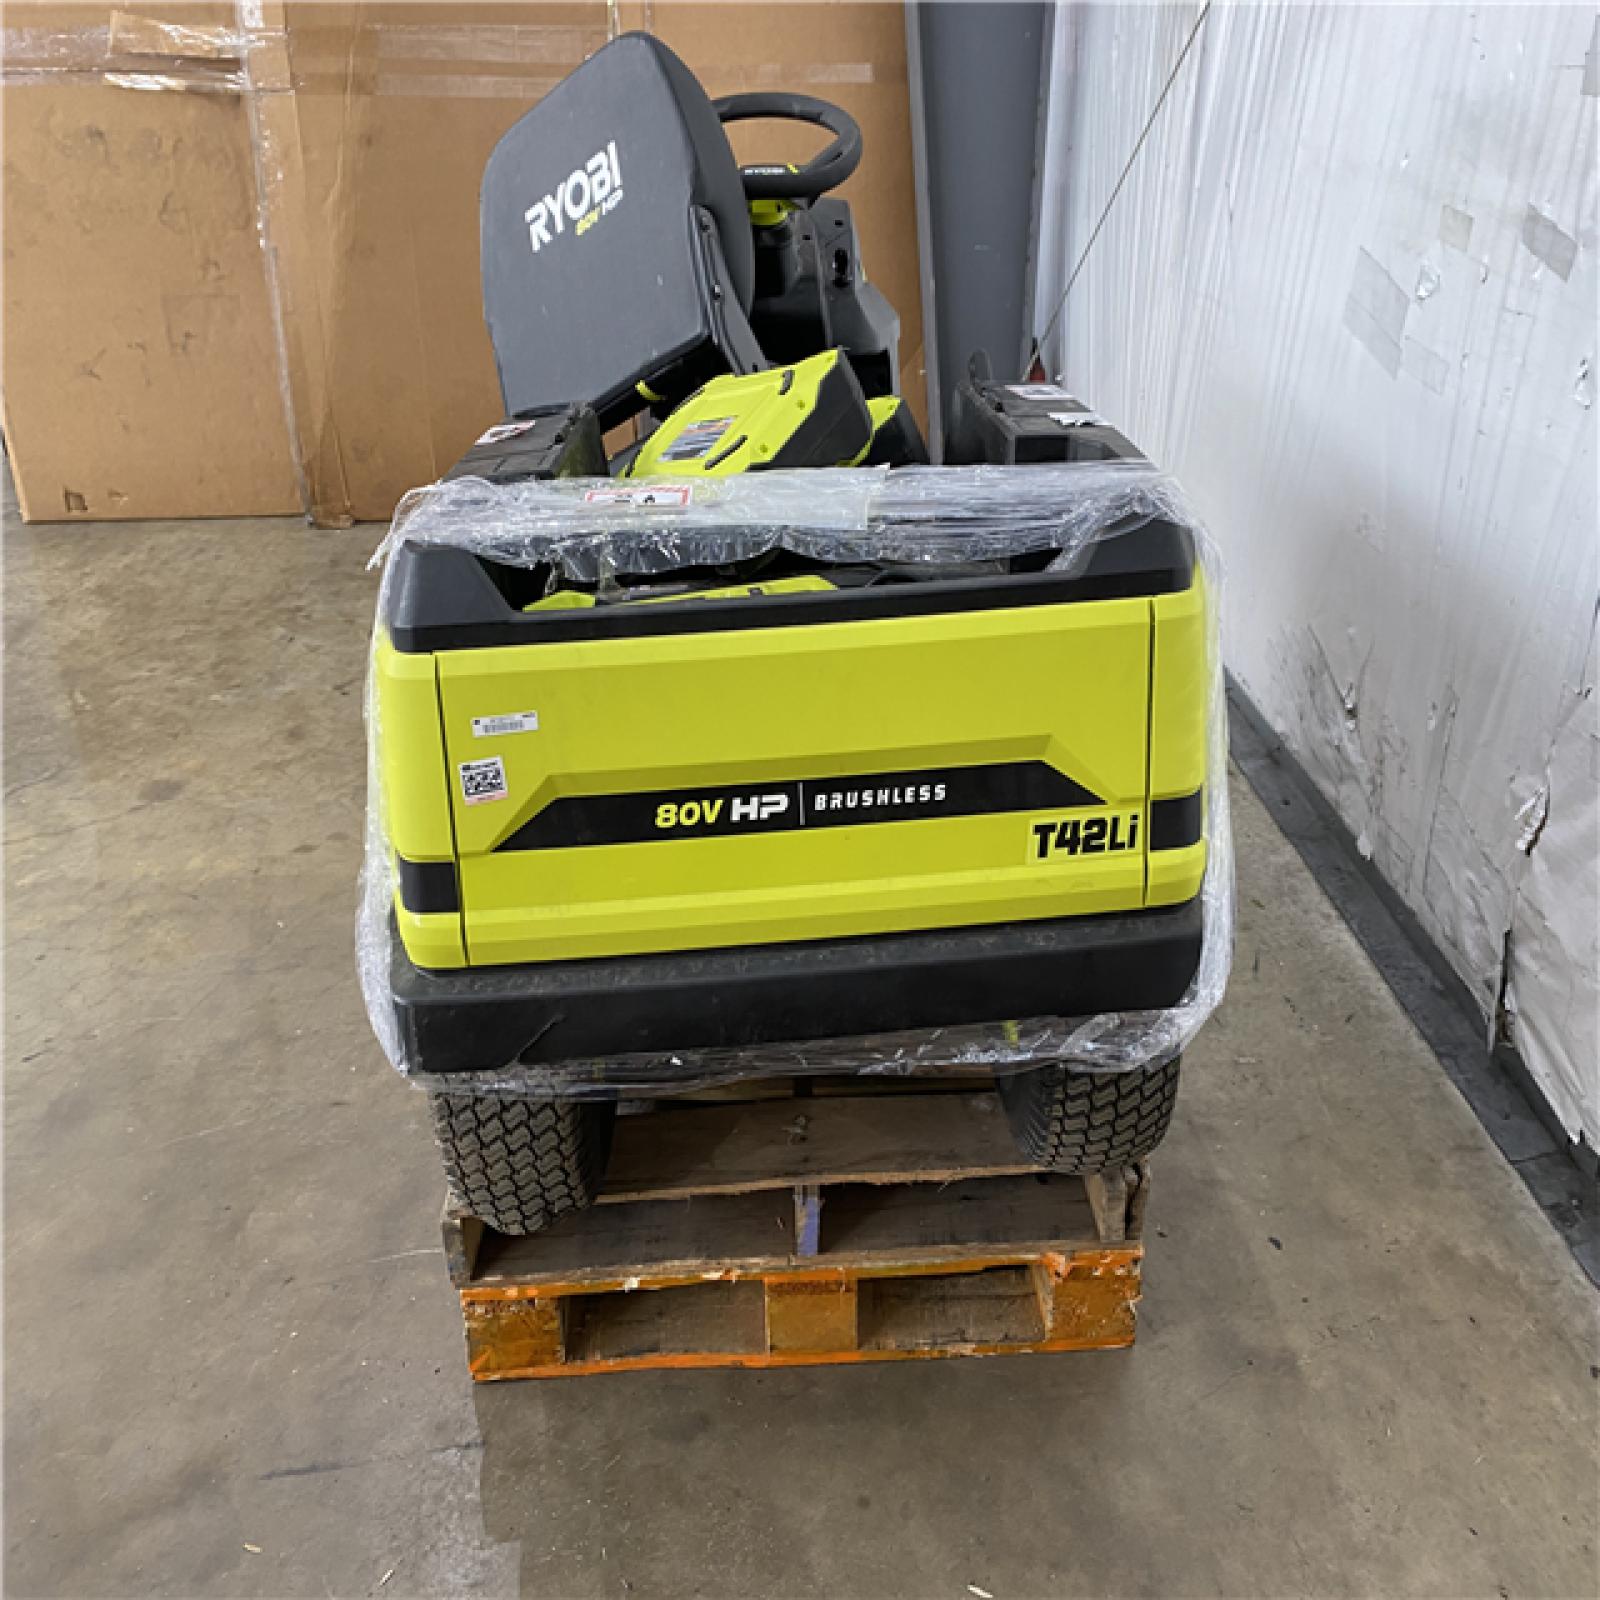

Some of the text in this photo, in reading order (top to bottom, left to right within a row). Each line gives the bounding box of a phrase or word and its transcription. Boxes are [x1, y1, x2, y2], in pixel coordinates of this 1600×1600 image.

[525, 140, 622, 253] RYOBI
[655, 784, 946, 828] 80V HP BRUSHLESS
[1033, 814, 1139, 858] T42Li
